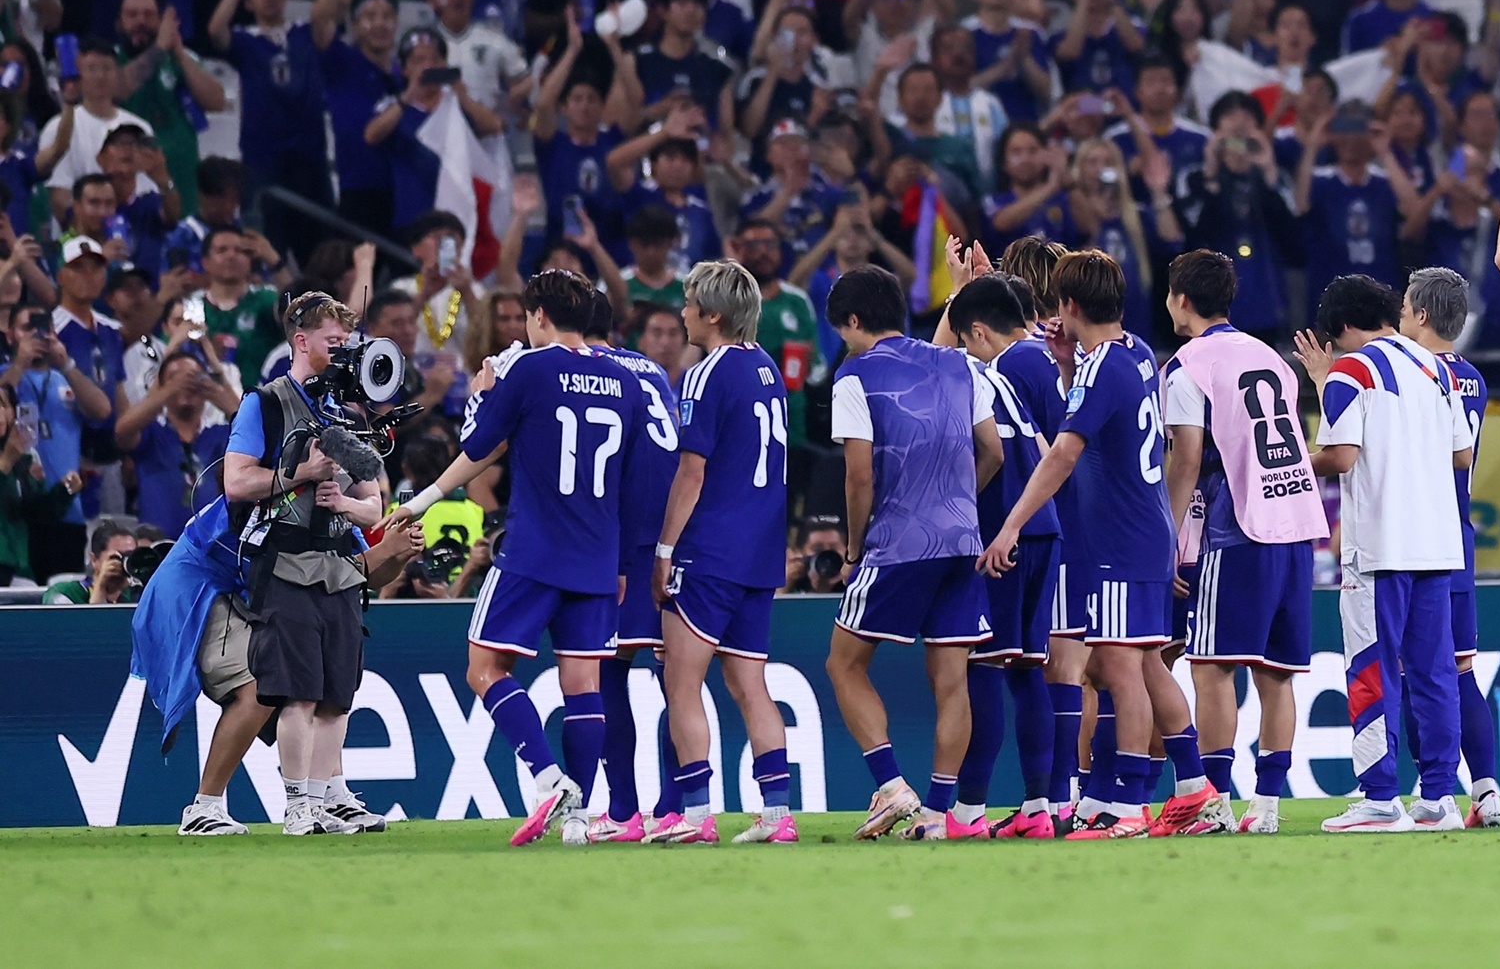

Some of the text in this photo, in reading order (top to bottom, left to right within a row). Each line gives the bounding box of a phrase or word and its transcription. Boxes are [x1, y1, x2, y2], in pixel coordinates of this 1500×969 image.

[558, 372, 622, 398] Y.SUZUKI
[639, 379, 679, 452] 3
[555, 405, 623, 498] 17
[1267, 446, 1292, 461] FIFA
[1260, 470, 1291, 483] WORLD
[1262, 478, 1313, 499] 2026
